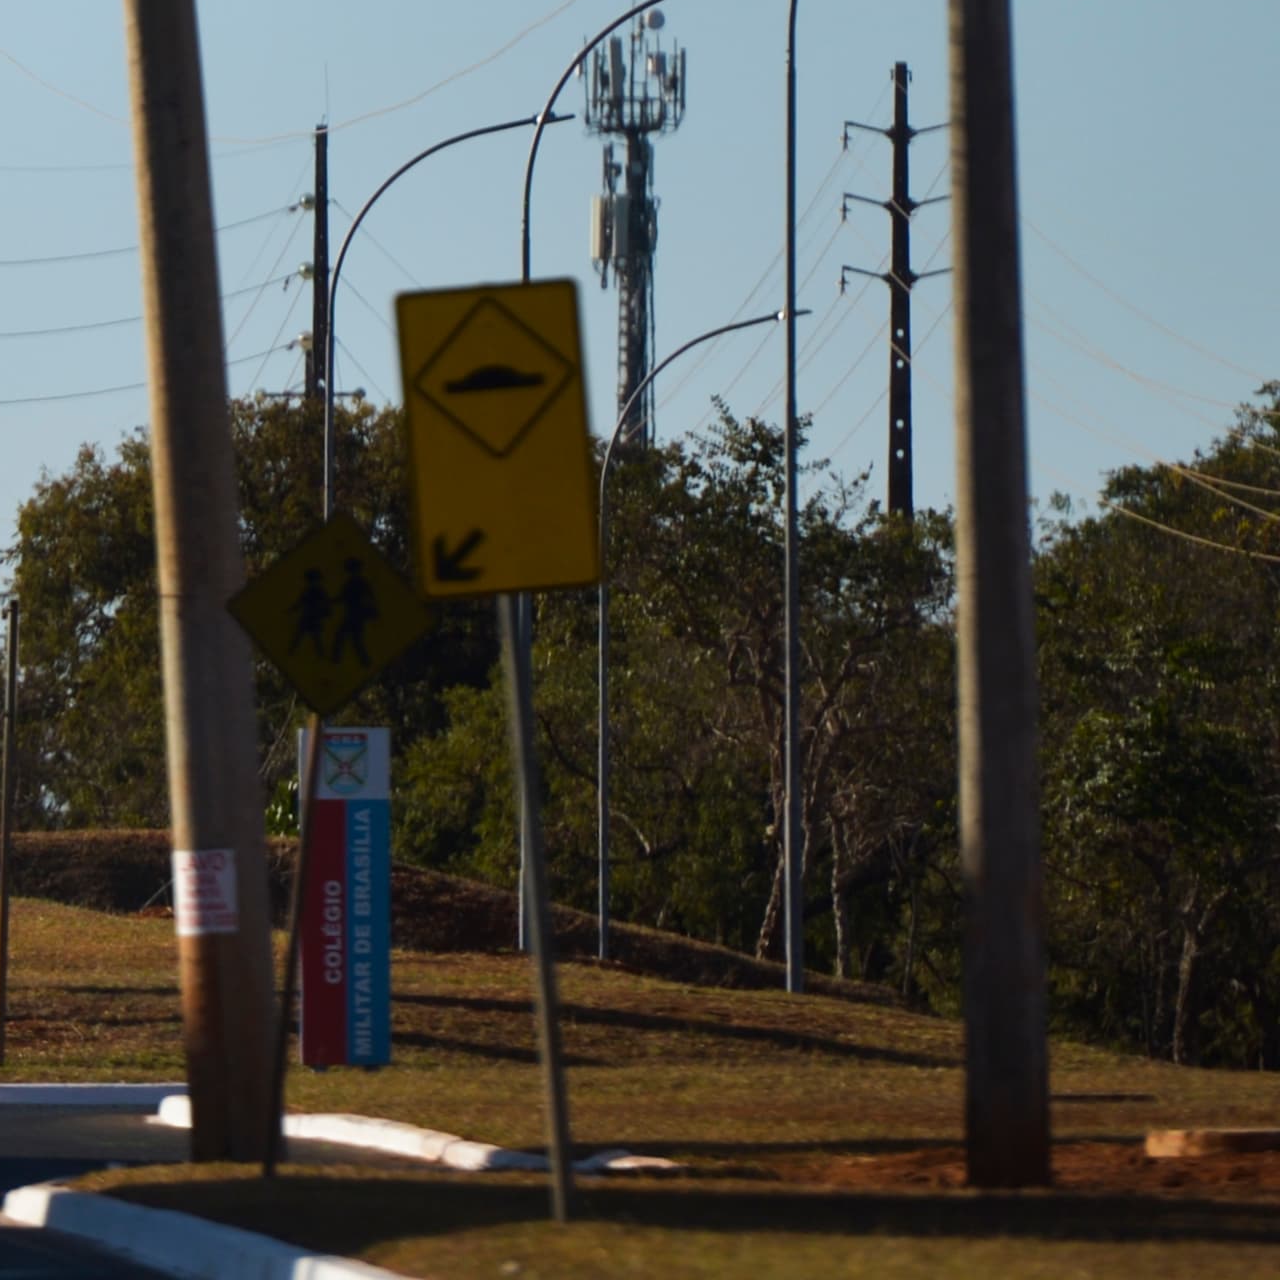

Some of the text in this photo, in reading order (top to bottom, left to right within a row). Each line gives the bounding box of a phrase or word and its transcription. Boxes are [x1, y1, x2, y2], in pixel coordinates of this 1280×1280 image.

[320, 879, 343, 985] COLÉGIO
[353, 807, 372, 1057] MILITAR DE BRASÍLIA
